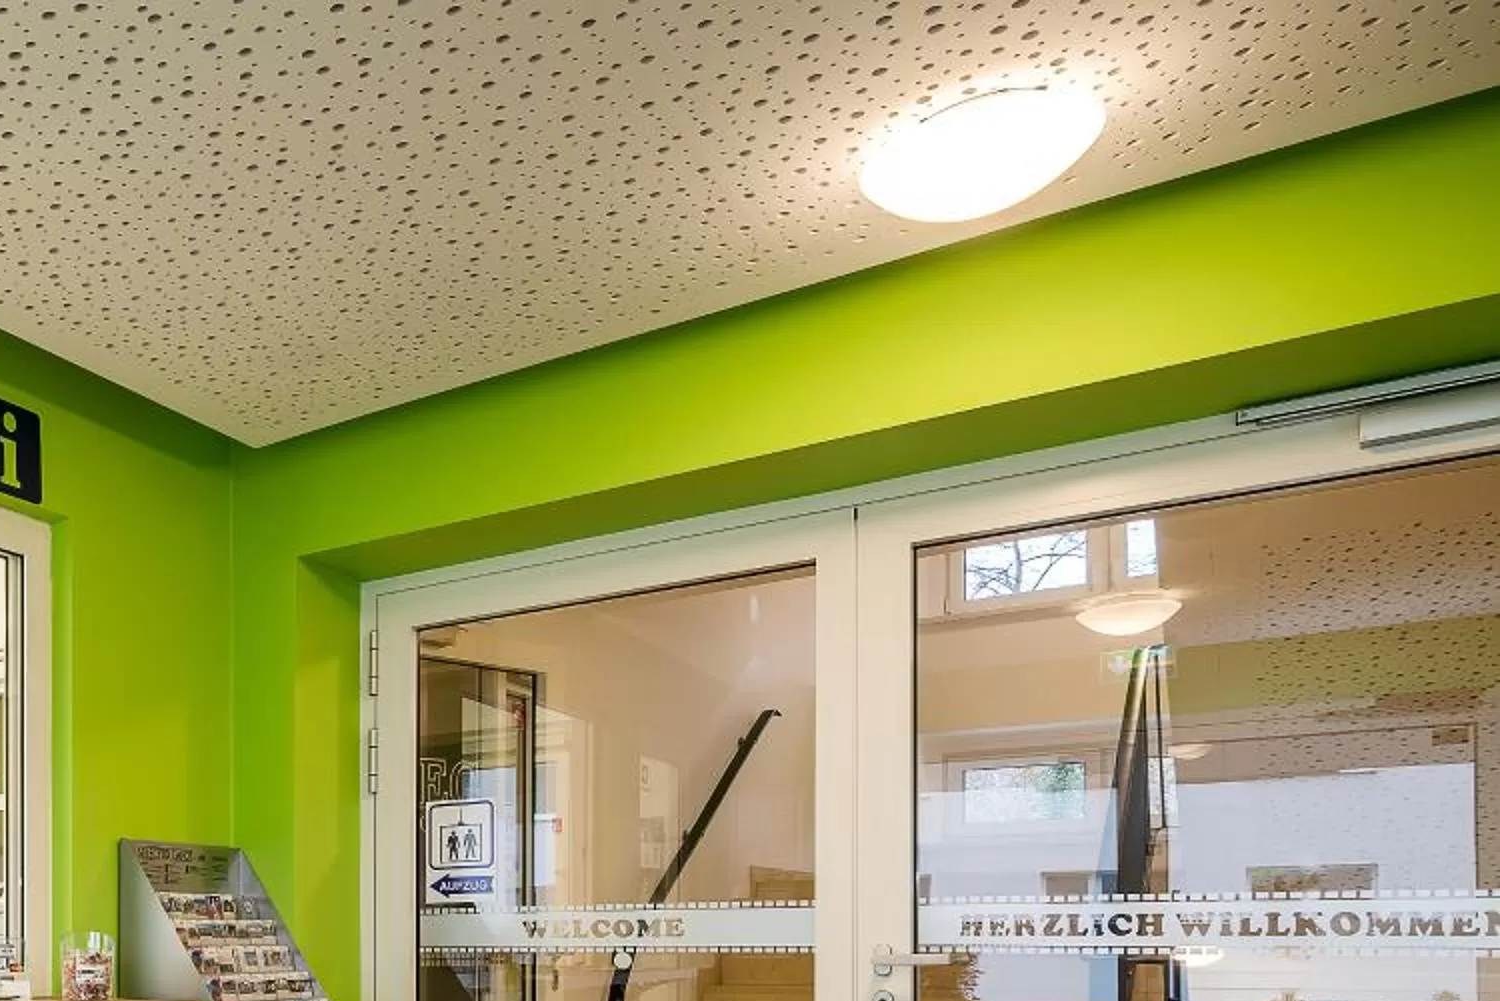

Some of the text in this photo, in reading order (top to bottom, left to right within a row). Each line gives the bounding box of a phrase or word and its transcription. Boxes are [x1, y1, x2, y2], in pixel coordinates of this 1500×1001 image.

[439, 879, 487, 892] AUFZUG
[521, 917, 685, 939] WELCOME
[959, 912, 1165, 938] HERZLICH
